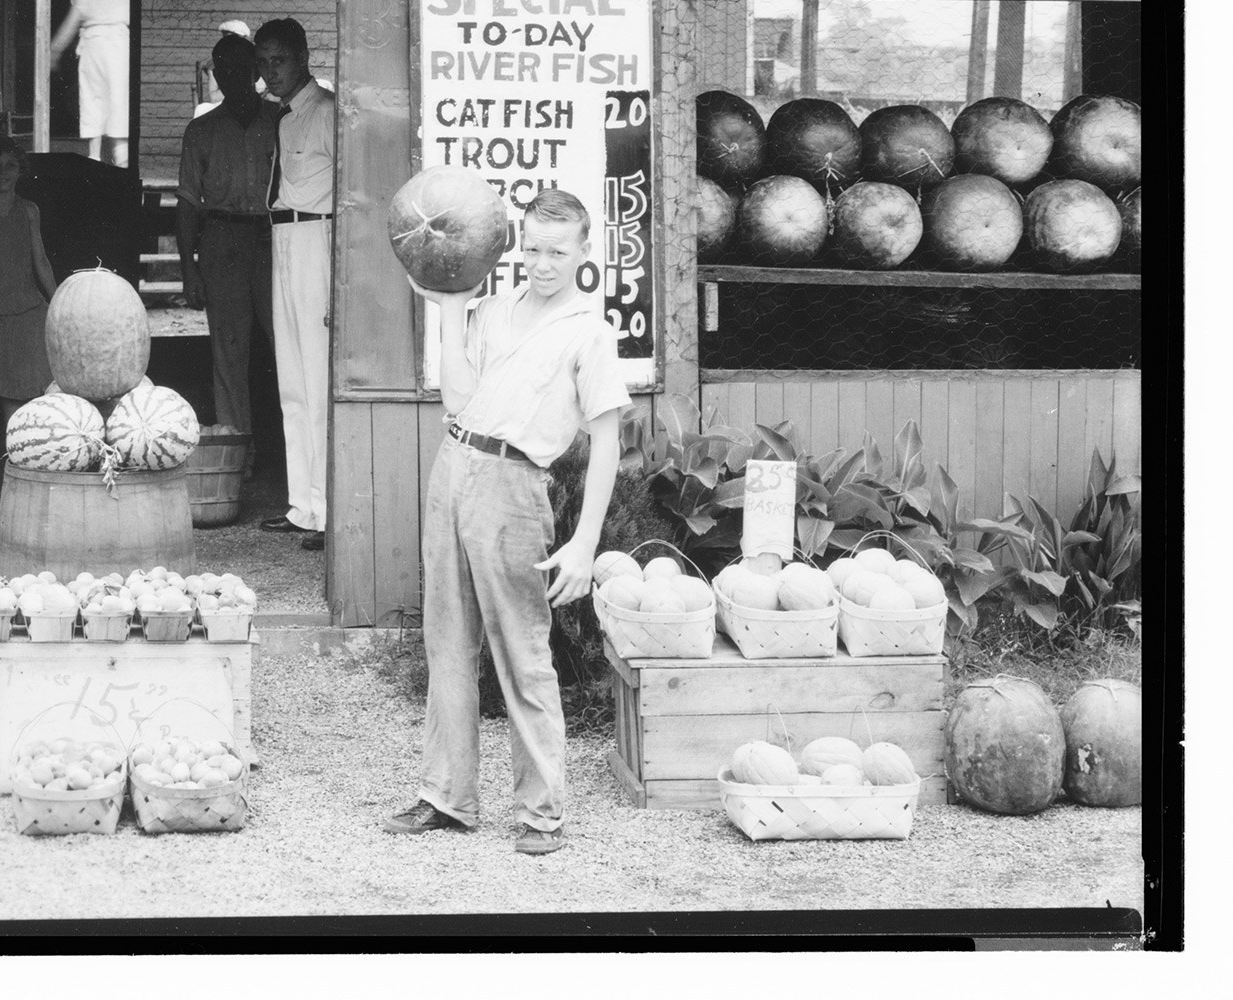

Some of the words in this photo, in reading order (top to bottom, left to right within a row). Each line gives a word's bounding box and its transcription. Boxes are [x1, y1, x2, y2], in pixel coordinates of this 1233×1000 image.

[456, 20, 595, 53] TO-DAY
[430, 51, 542, 83] RIVER
[551, 53, 639, 86] FISH
[604, 96, 648, 130] 20
[436, 135, 567, 171] TROUT
[605, 168, 648, 226] 15
[605, 219, 647, 268] 15
[605, 265, 647, 305] 15
[606, 308, 647, 340] 20
